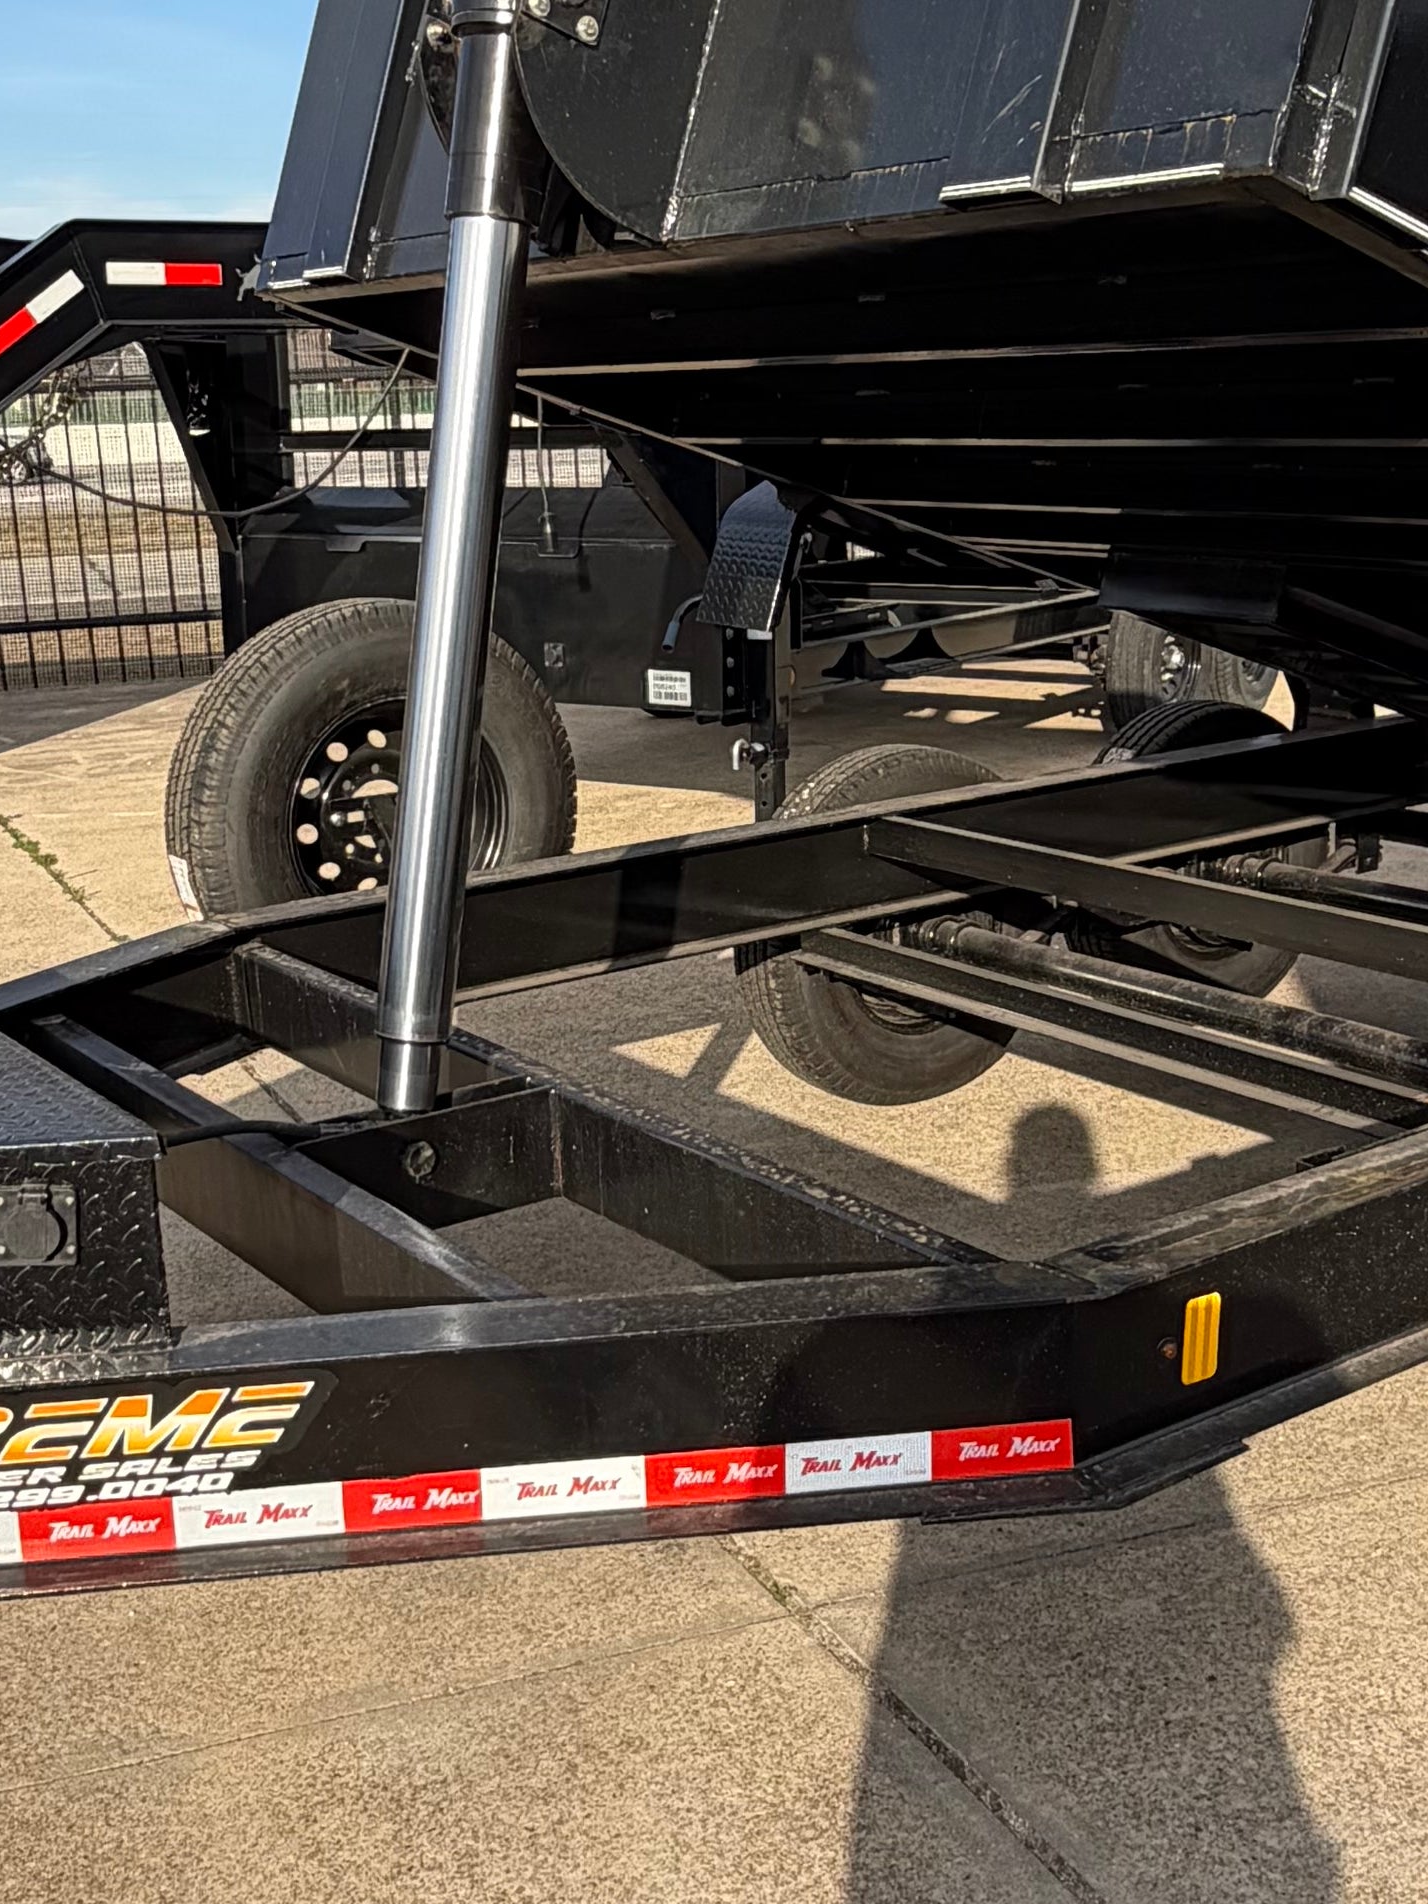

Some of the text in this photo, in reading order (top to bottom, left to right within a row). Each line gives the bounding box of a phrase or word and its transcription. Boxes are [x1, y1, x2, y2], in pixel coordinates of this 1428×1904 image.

[959, 1436, 1061, 1460] TRAIL MAXX
[78, 1449, 262, 1481] SALES
[673, 1461, 778, 1487] TRAIL MAXX
[800, 1451, 901, 1475] TRAIL MAXX
[372, 1488, 481, 1514] TRAIL MAXX
[516, 1476, 621, 1501] TRAIL MAXX
[203, 1503, 313, 1528] TRAIL MAXX
[48, 1516, 162, 1543] TRAIL MAXX
